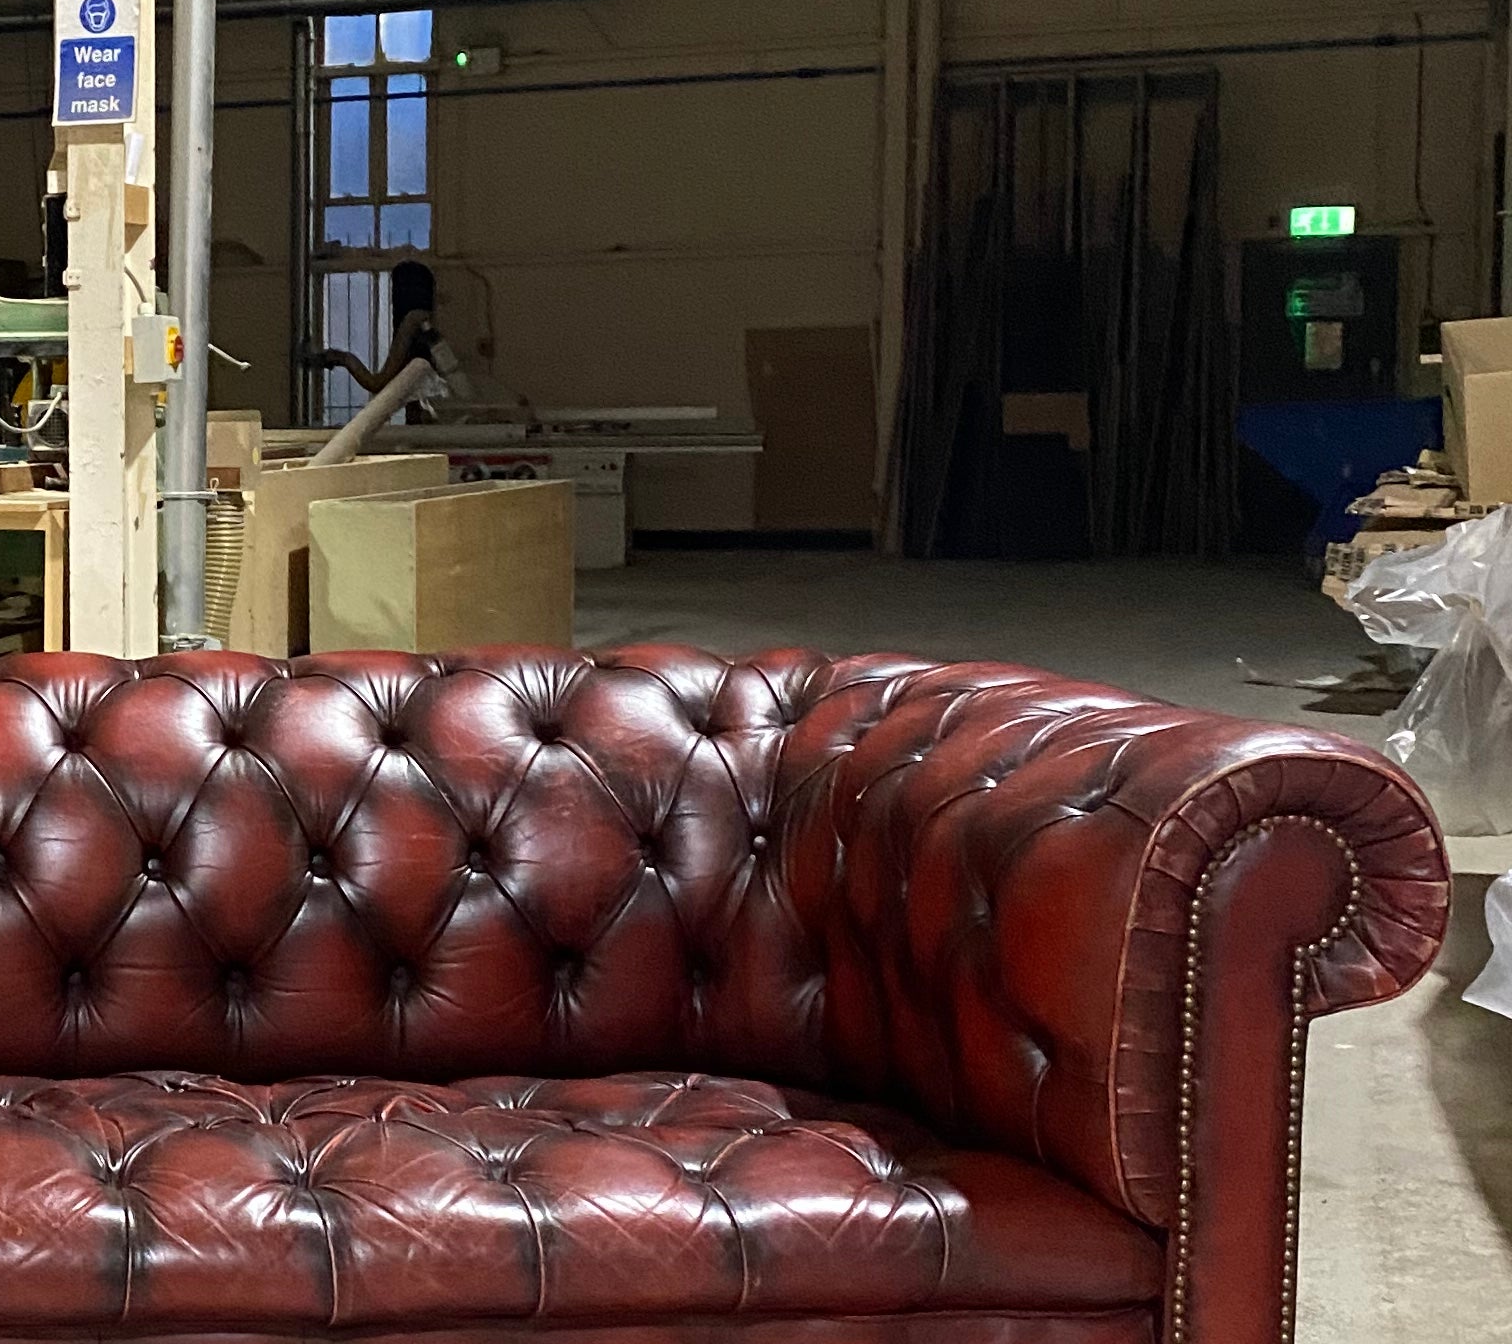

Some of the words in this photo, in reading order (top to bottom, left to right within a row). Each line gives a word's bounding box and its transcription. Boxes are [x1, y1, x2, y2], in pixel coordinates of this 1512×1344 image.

[73, 45, 122, 64] Wear
[77, 71, 117, 89] face
[70, 95, 121, 114] mask
